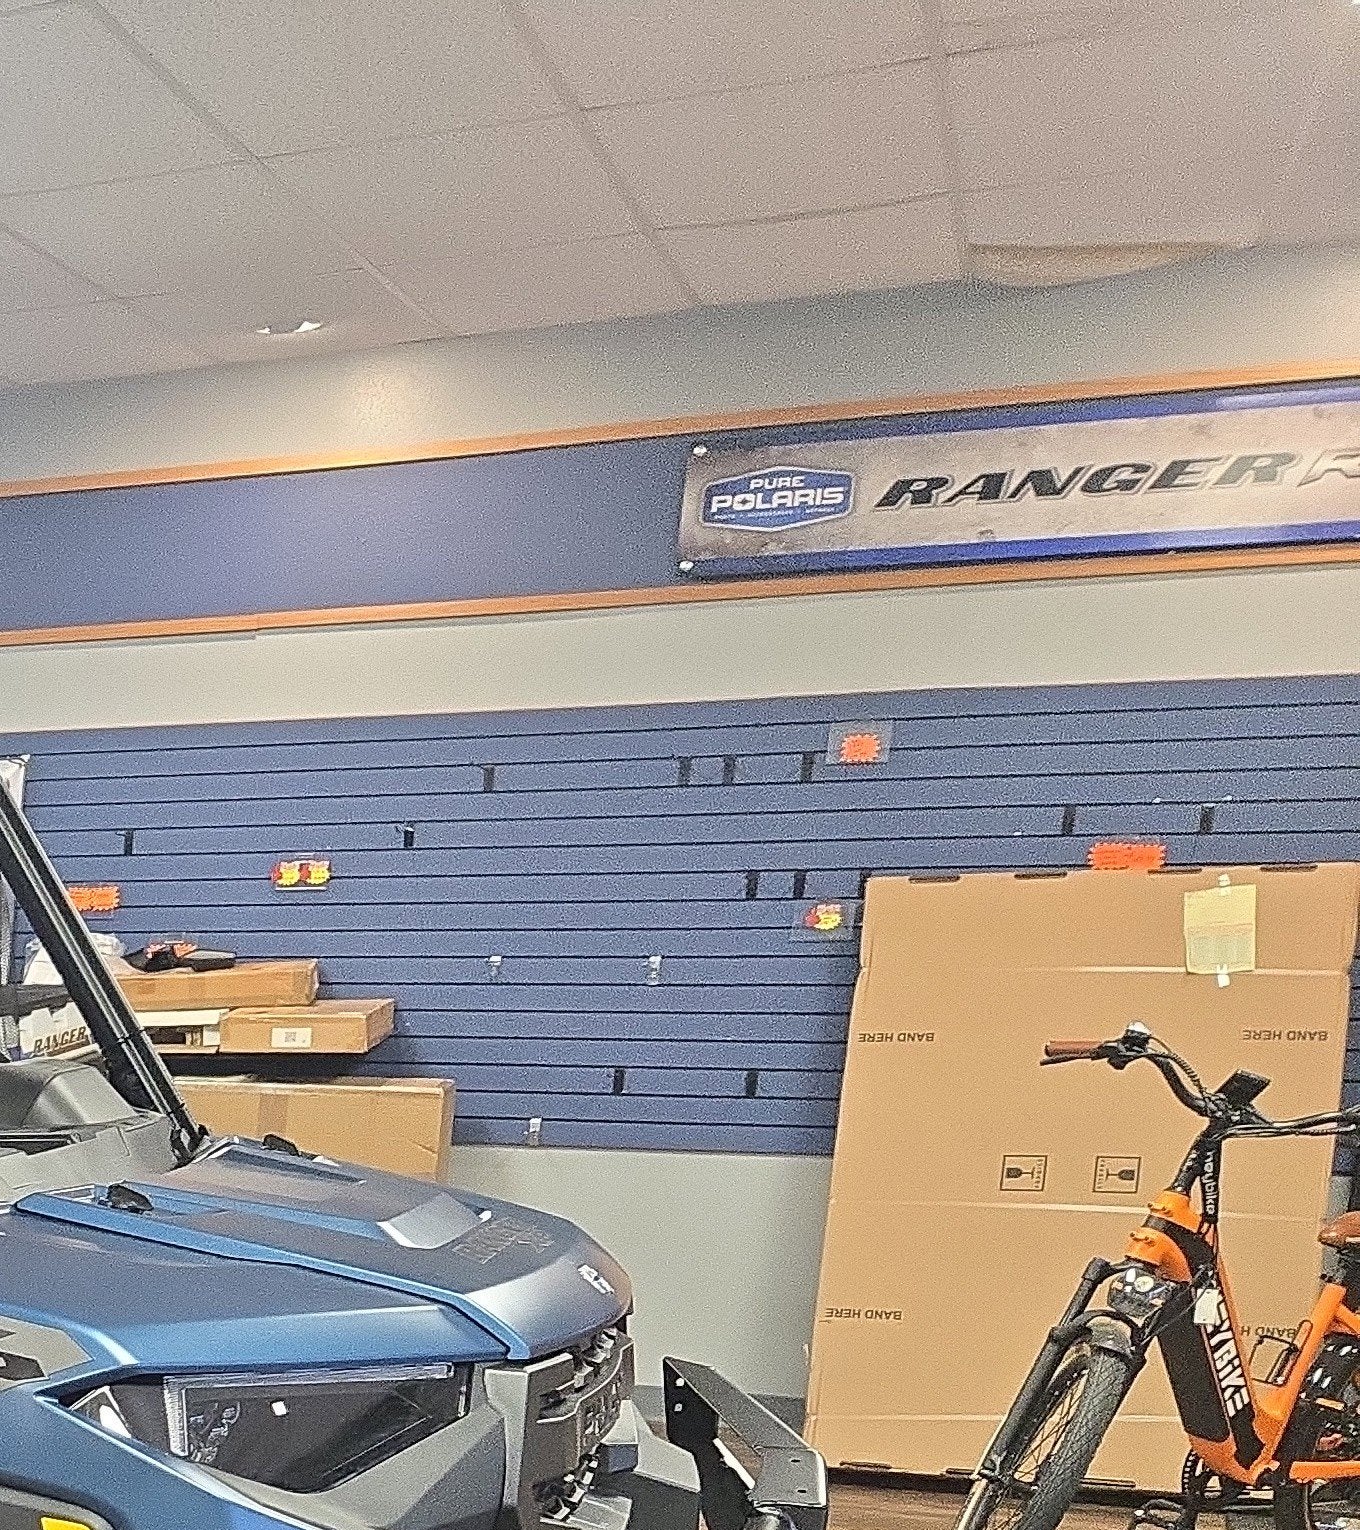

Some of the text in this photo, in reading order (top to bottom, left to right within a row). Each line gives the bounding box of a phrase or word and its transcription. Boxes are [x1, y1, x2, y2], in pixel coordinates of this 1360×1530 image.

[749, 475, 806, 490] PURE
[872, 452, 1297, 508] RANGER
[710, 487, 847, 513] POLARIS
[33, 1025, 87, 1052] RANGER
[857, 1032, 935, 1043] BAND HERE
[1242, 1029, 1329, 1041] BAND HERE
[824, 1307, 903, 1321] BAND HERE
